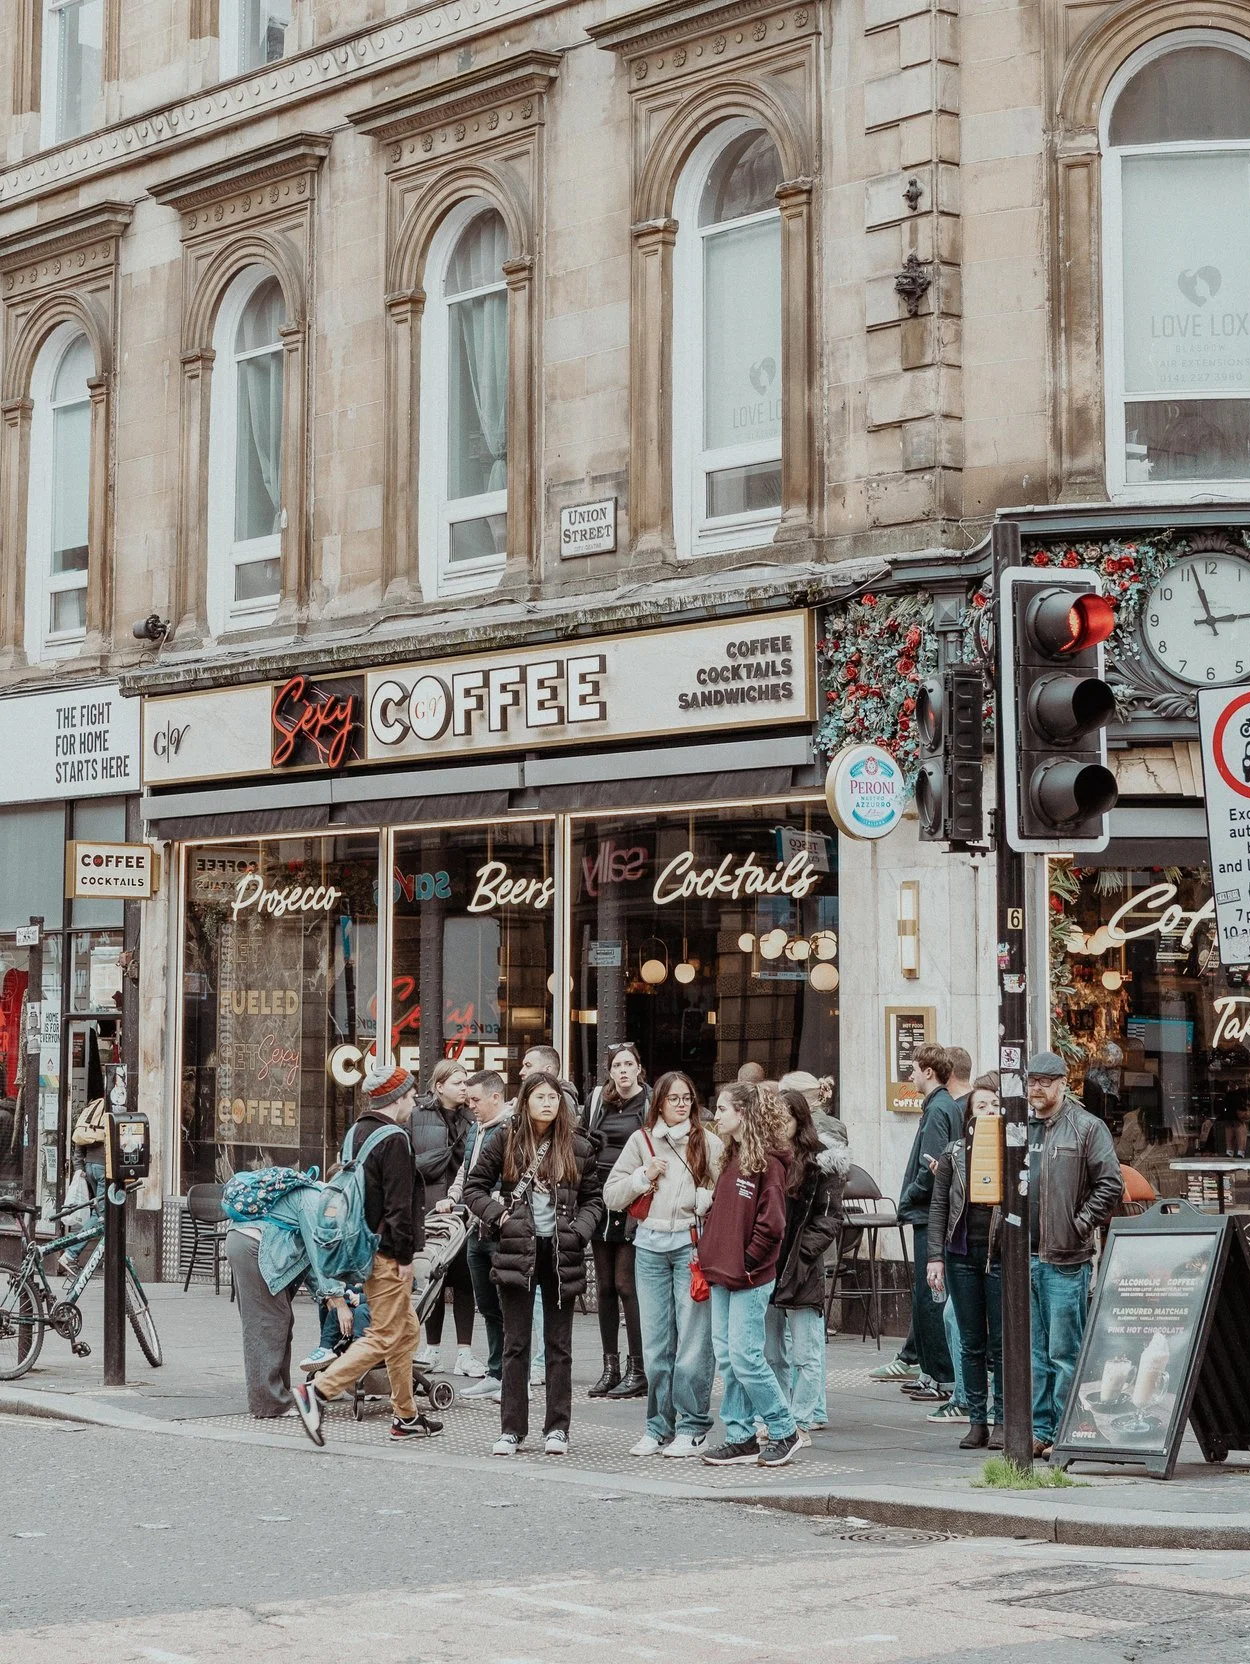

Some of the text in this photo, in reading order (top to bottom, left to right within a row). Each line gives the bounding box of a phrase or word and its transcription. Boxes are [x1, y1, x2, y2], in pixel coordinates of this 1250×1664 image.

[1151, 312, 1249, 338] LOVE LOX
[1181, 357, 1250, 368] EXTENSIONS
[732, 397, 782, 429] LOVE LO
[568, 507, 607, 526] UNION
[563, 524, 613, 544] STREET
[1181, 568, 1190, 582] 11
[1204, 561, 1218, 575] 12
[1159, 587, 1173, 601] 10
[1150, 613, 1160, 627] 9
[726, 635, 793, 659] COFFEE
[1158, 640, 1168, 654] 8
[696, 658, 793, 686] COCKTAILS
[1178, 659, 1188, 673] 7
[1206, 667, 1216, 681] 6
[1234, 660, 1244, 674] 5
[370, 653, 607, 745] COFFEE
[678, 681, 793, 710] SANDWICHES
[56, 701, 112, 730] THE FIGHT
[272, 675, 354, 768] Sexy
[55, 729, 109, 757] FOR HOME
[55, 755, 130, 784] STARTS HERE
[849, 779, 895, 795] PERONI
[81, 853, 145, 870] COFFEE
[1218, 859, 1243, 873] and
[80, 875, 145, 887] COCKTAILS
[467, 861, 556, 913] Beers
[653, 850, 818, 905] Cocktails
[231, 873, 342, 921] Prosecco
[1010, 909, 1020, 928] 6
[219, 989, 300, 1015] FUELED
[44, 1023, 60, 1032] IS FOR
[257, 1033, 300, 1086] Sexy
[217, 1097, 297, 1127] COFFEE
[1119, 1278, 1160, 1286] ALCOHOLIC
[1112, 1307, 1189, 1315] FLAVOURED MATCHAS
[1108, 1326, 1185, 1334] PINK HOT CHOCOLATE
